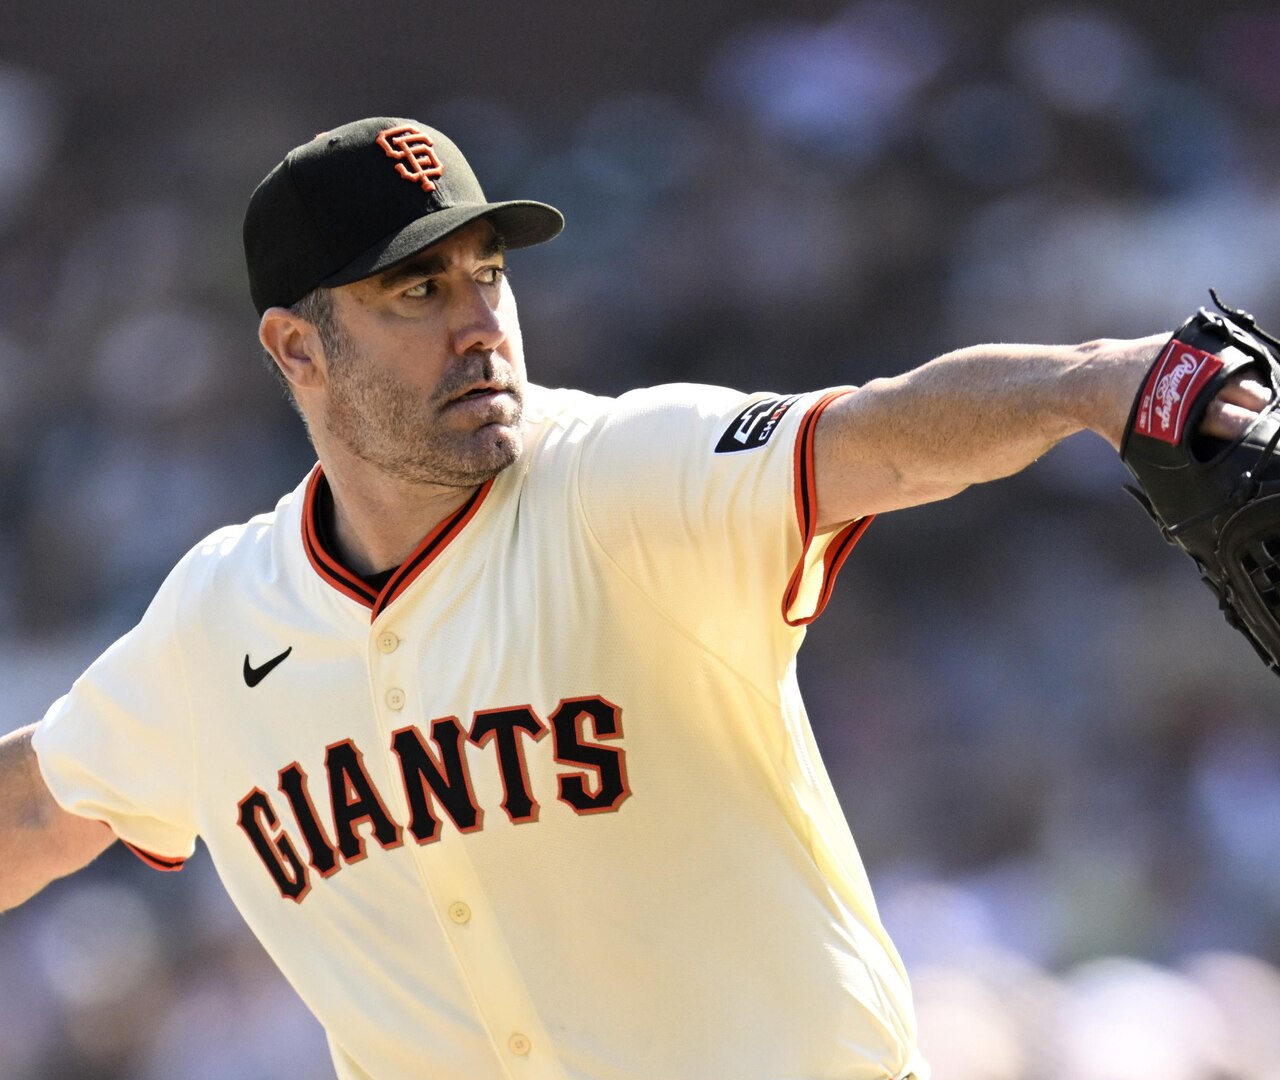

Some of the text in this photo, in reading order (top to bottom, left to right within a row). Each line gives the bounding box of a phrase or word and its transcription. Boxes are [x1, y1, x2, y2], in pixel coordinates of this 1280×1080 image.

[376, 125, 444, 192] SF
[1155, 353, 1197, 431] Rawlings
[237, 694, 633, 904] GIANTS
